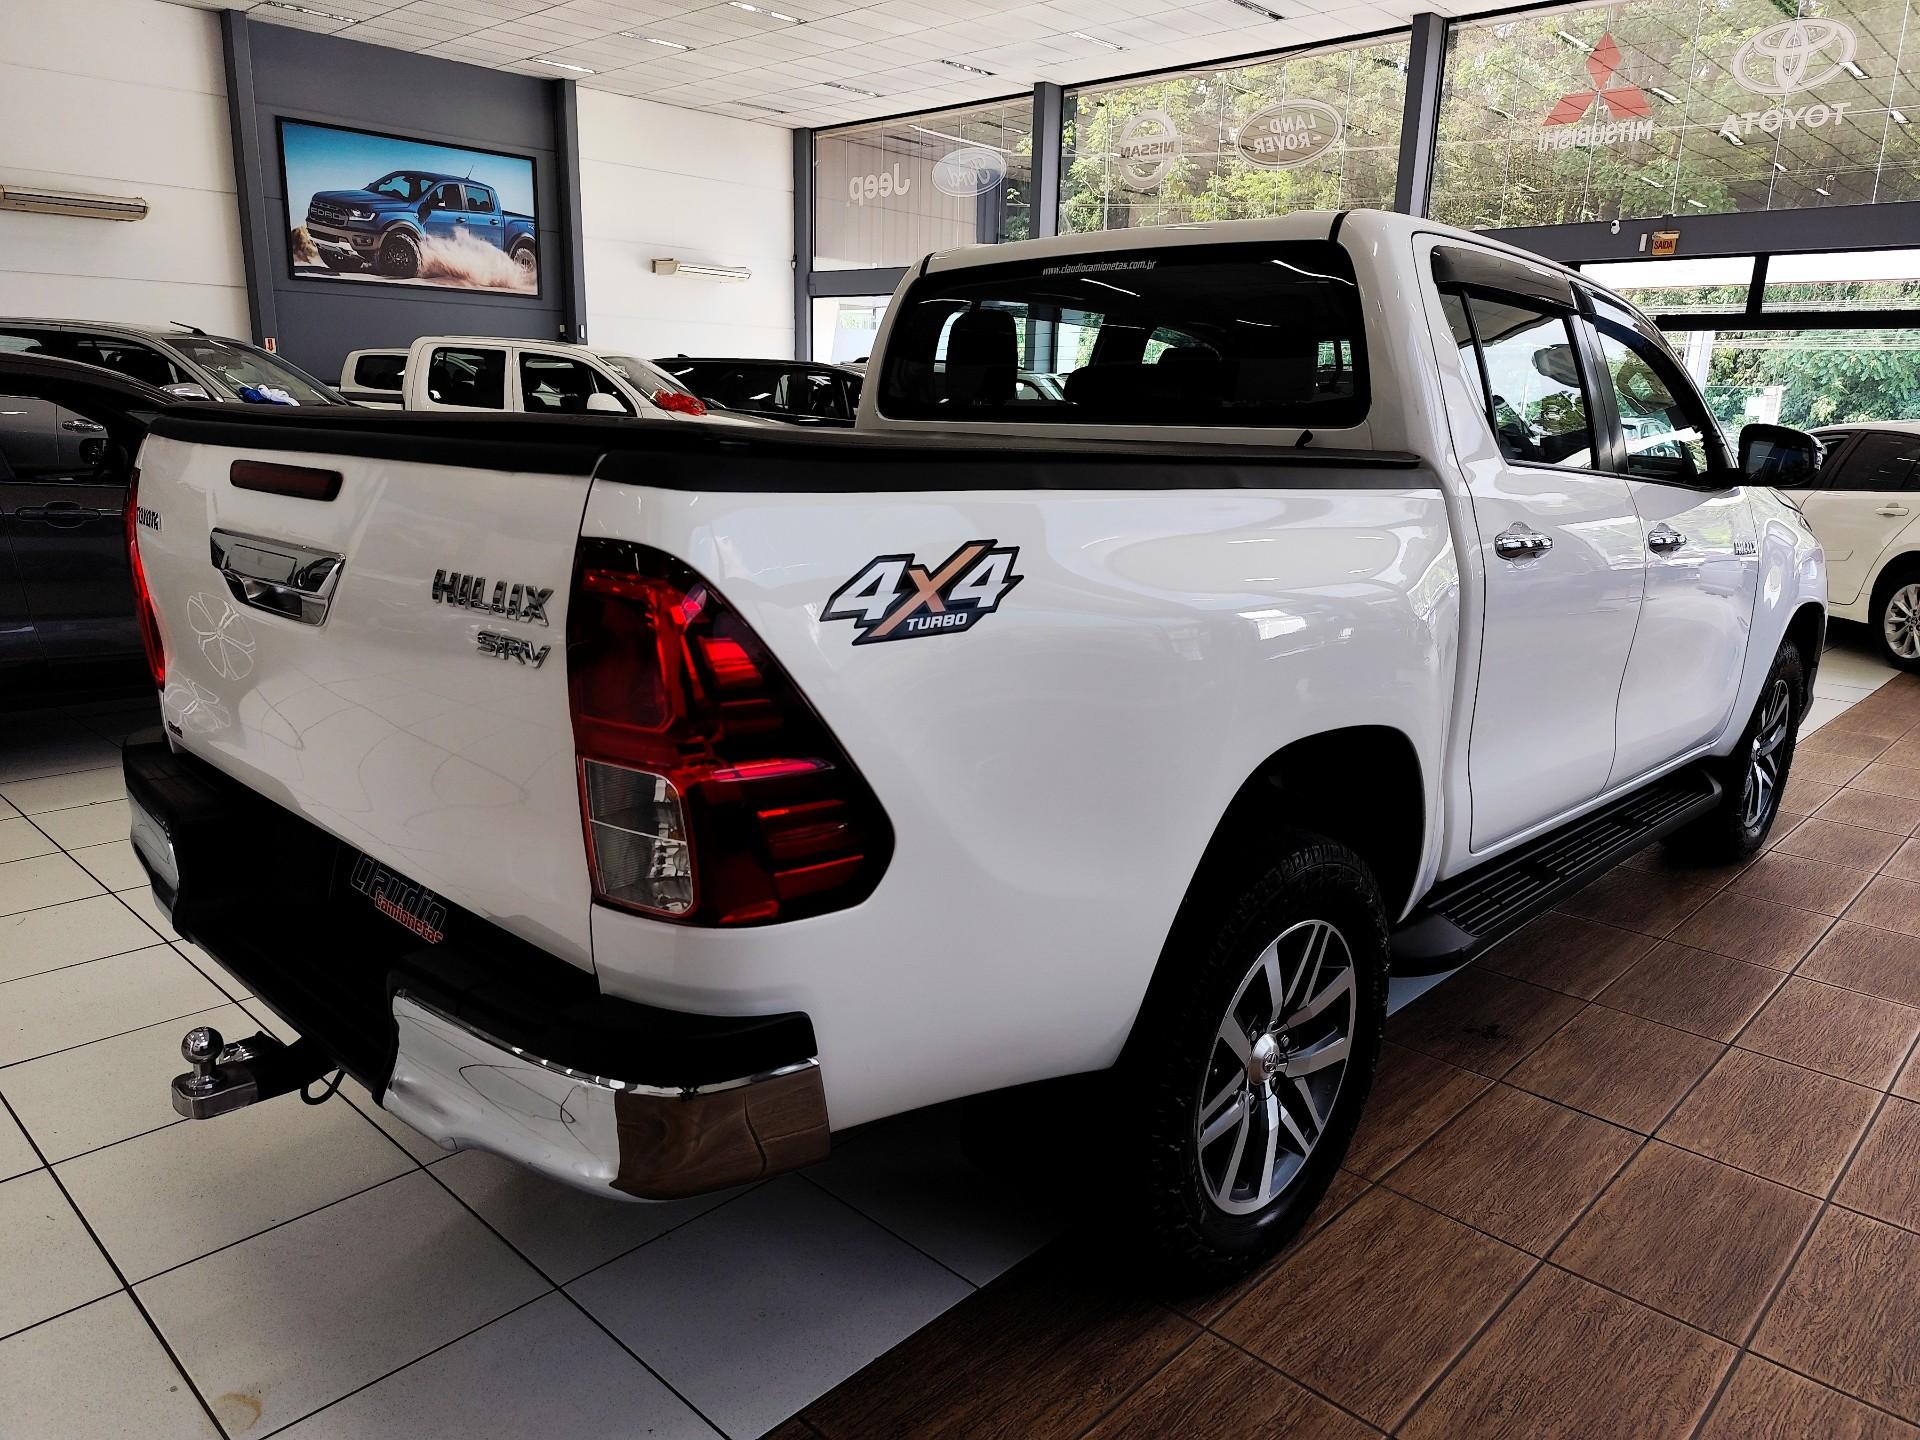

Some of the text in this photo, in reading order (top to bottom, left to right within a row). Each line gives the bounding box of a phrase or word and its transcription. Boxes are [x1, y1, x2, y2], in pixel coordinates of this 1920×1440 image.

[311, 208, 341, 219] FORD
[1043, 260, 1157, 275] www.claudiocamionetas.com.br
[432, 569, 554, 627] HILUX
[907, 612, 968, 631] TURBO
[478, 631, 551, 669] SRV
